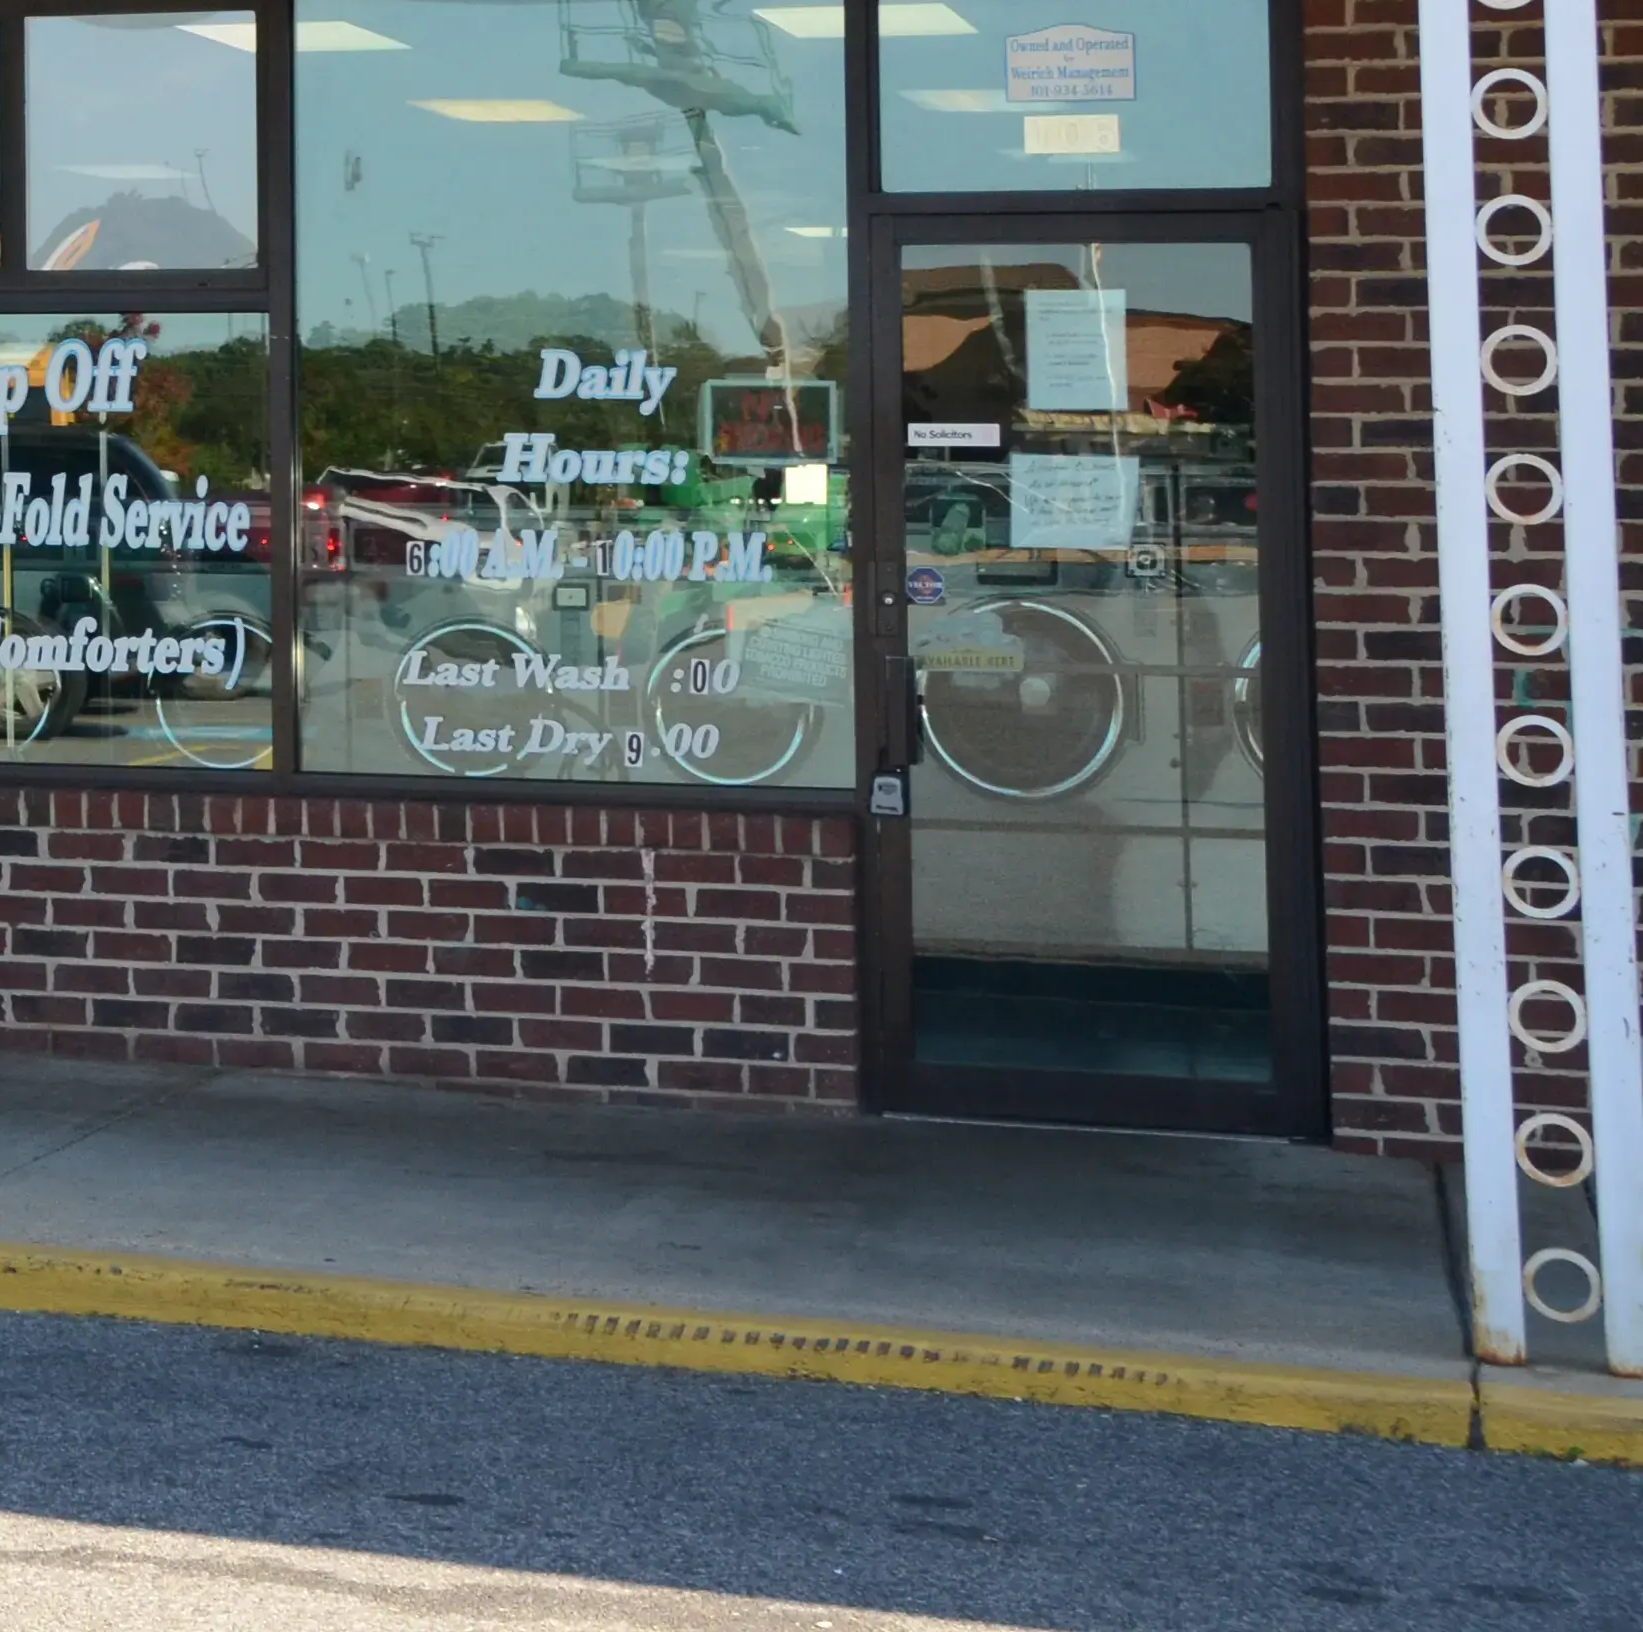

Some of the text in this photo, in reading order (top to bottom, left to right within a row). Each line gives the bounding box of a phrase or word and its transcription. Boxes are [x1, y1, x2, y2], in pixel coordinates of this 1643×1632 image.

[1011, 37, 1129, 55] Owned and Operated
[1057, 66, 1129, 82] Management
[45, 339, 146, 413] Off
[534, 349, 677, 416] Daily
[496, 433, 689, 485] Hours:
[915, 430, 972, 439] No Solicitors
[99, 474, 250, 551] Service
[407, 528, 478, 579] 6:00
[482, 528, 564, 580] A.M.
[597, 529, 686, 582] 10:00
[688, 531, 772, 582] P.M.
[403, 650, 500, 688] Last
[512, 653, 630, 691] Wash
[419, 716, 515, 752] Last
[523, 718, 612, 765] Dry
